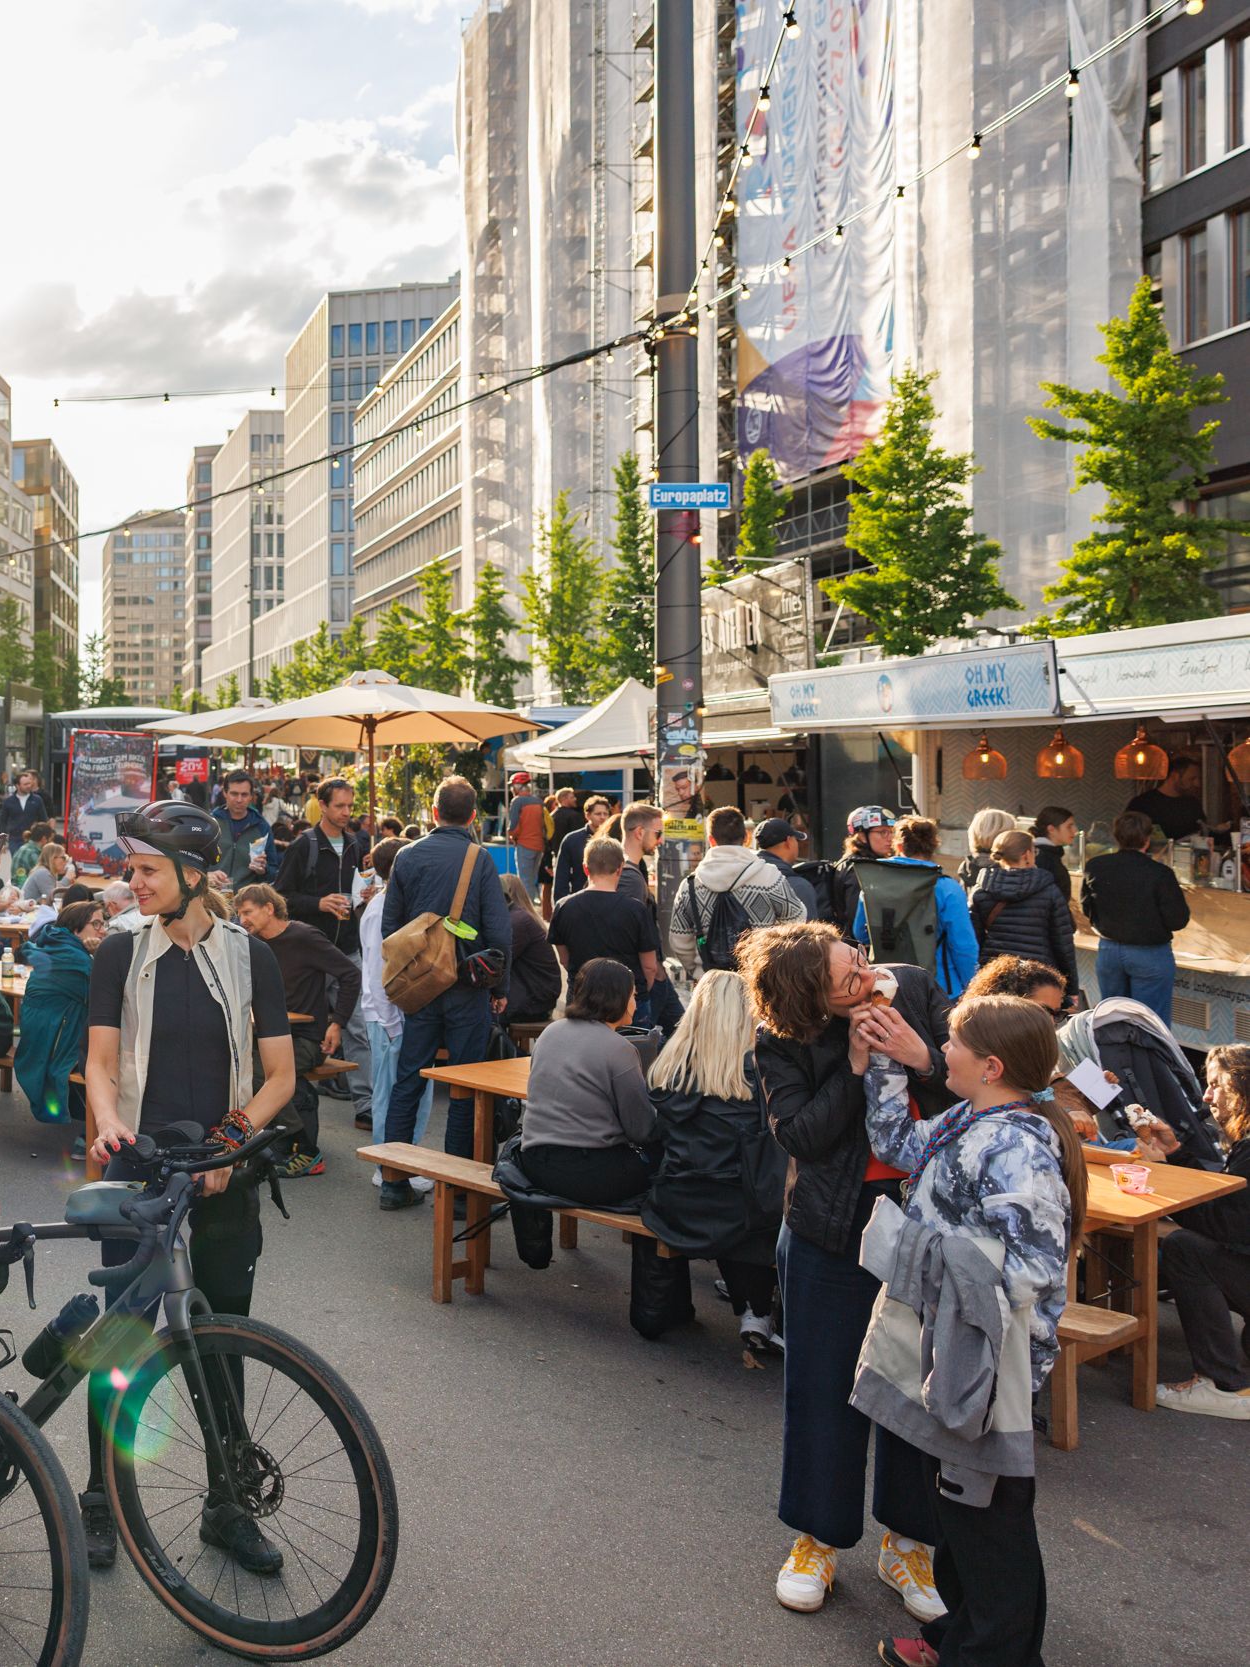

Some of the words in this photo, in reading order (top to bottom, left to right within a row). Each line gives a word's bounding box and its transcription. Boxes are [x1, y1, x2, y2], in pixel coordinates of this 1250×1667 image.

[653, 488, 727, 506] Europaplatz
[965, 667, 983, 685] OH
[987, 663, 1006, 682] MY
[790, 685, 801, 699] OH
[803, 683, 816, 698] MY
[967, 687, 1011, 707] GREEK!
[791, 704, 819, 718] GREEK!
[180, 762, 204, 772] 20%
